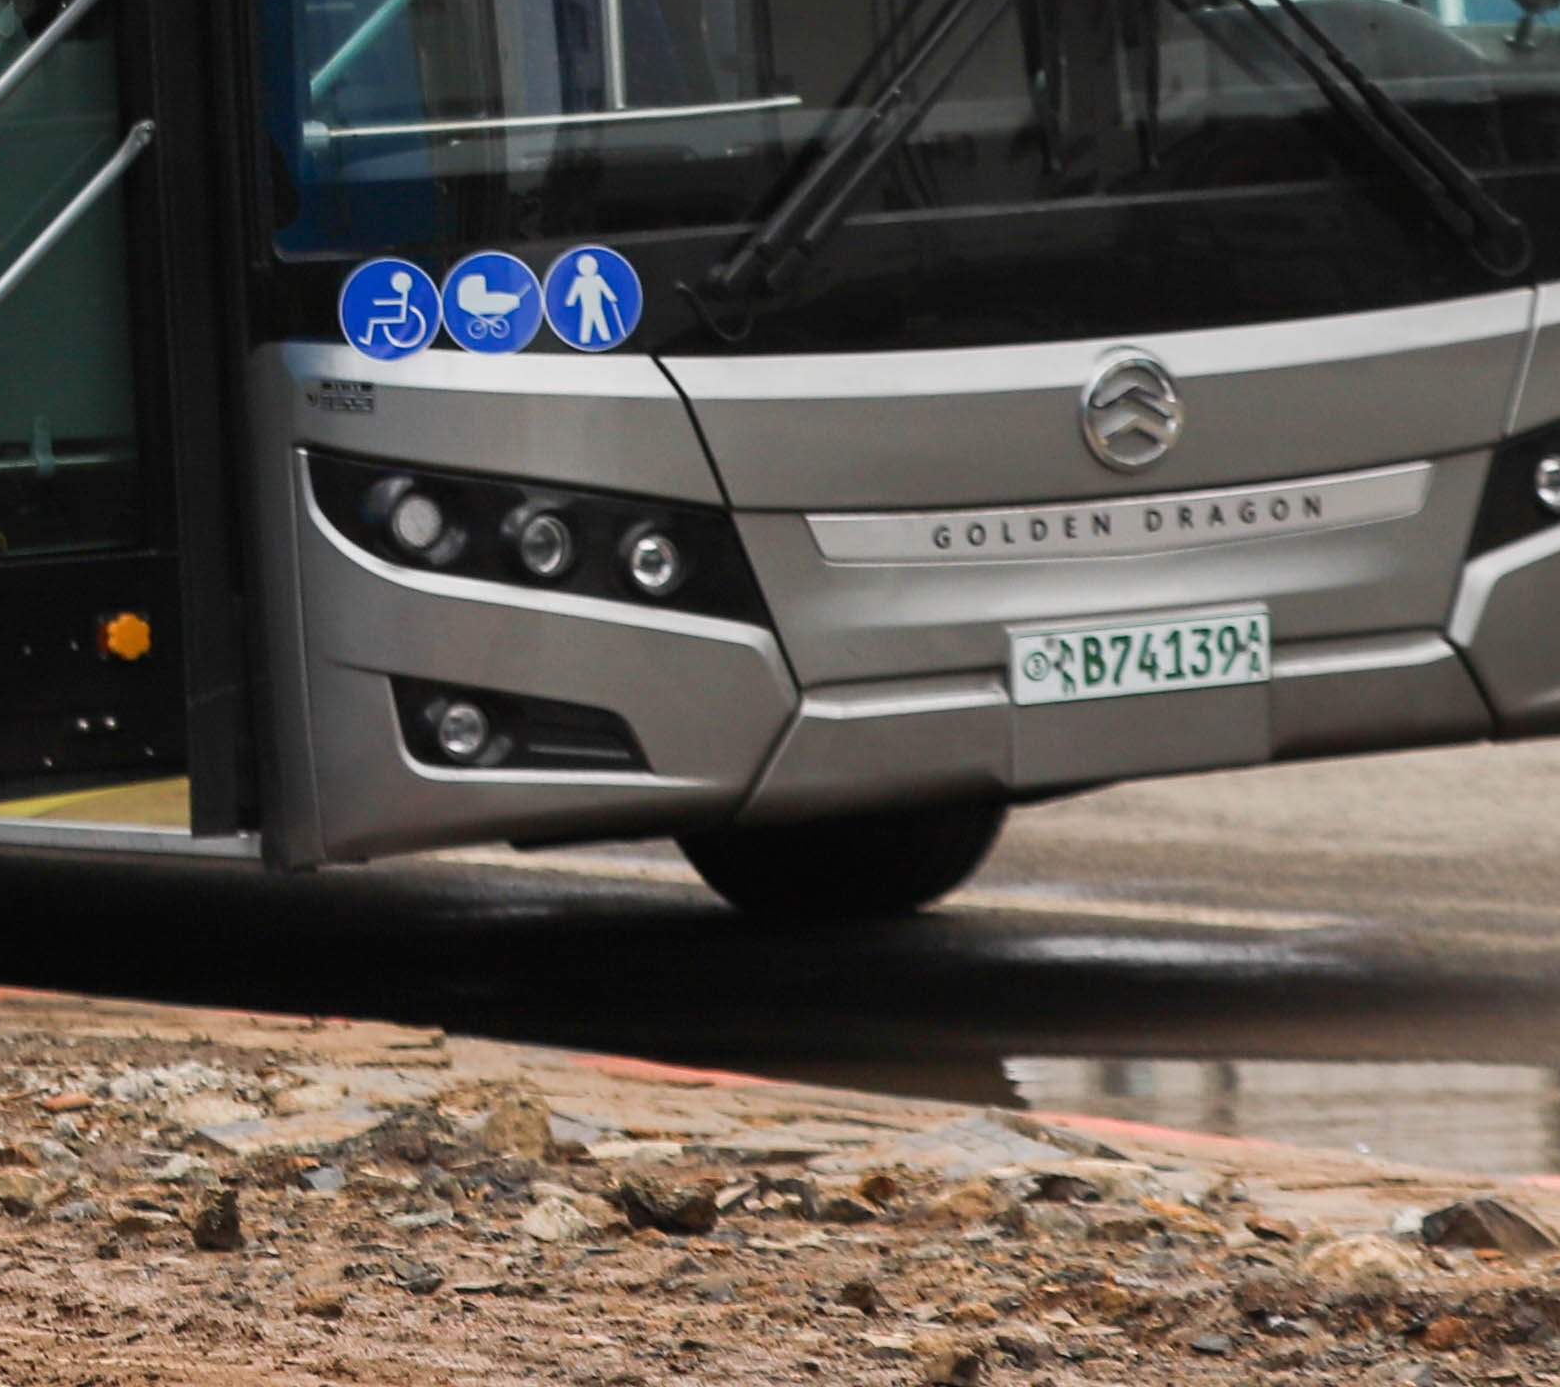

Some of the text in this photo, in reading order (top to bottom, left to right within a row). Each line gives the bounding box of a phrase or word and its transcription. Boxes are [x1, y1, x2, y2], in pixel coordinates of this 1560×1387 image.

[932, 494, 1323, 550] GOLDEN DRAGON
[1082, 623, 1240, 688] B74139
